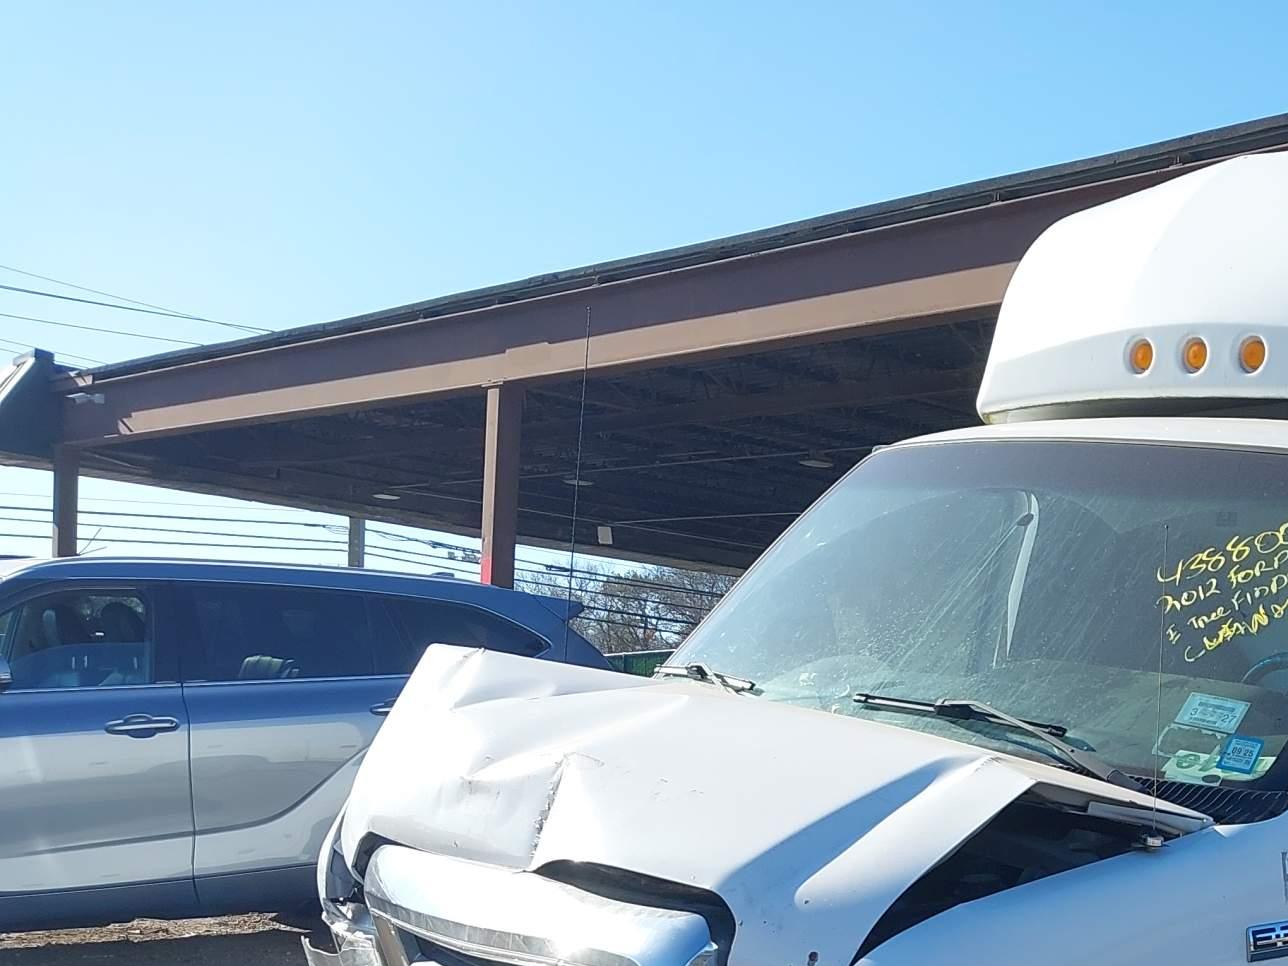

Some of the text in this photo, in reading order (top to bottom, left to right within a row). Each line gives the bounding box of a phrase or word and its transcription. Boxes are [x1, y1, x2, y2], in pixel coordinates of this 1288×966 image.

[1154, 578, 1222, 615] 2012
[1220, 713, 1238, 724] 27
[1231, 746, 1243, 755] 09
